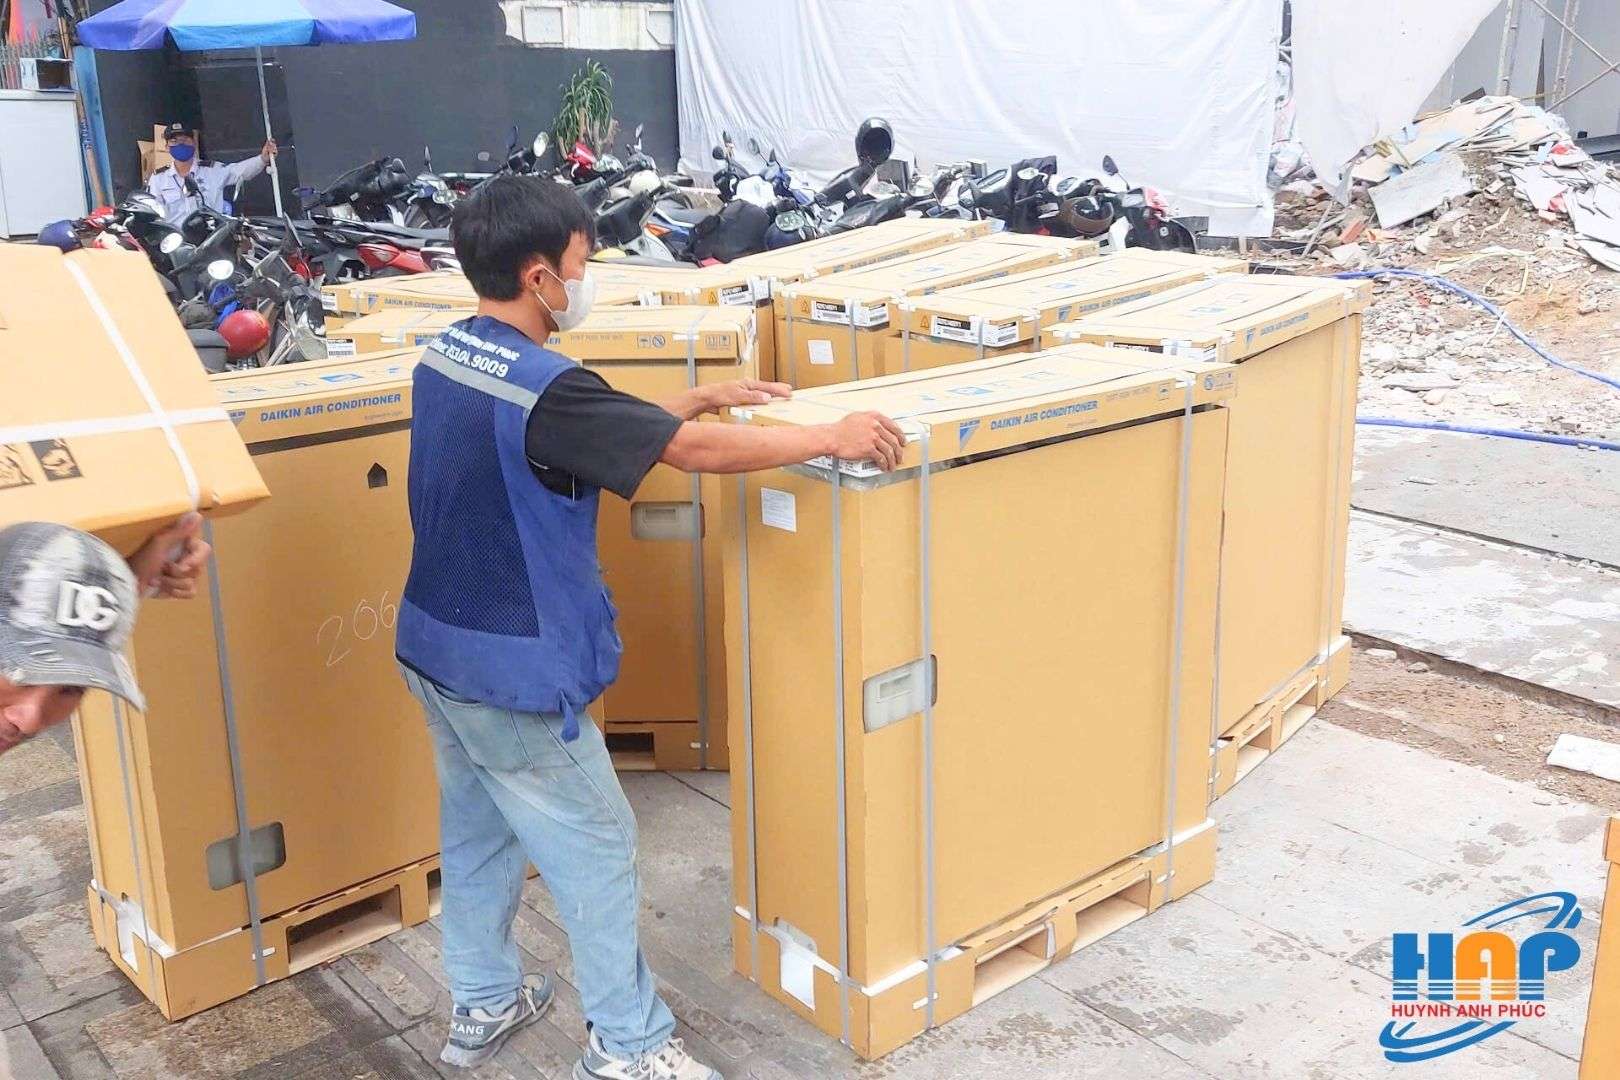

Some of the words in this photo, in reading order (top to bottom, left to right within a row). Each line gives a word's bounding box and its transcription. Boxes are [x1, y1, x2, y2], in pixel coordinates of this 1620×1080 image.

[260, 410, 301, 422] DAIKIN
[304, 405, 324, 416] AIR
[327, 393, 402, 413] CONDITIONER
[990, 416, 1022, 430] DAIKIN
[1023, 412, 1039, 424] AIR
[1040, 400, 1098, 420] CONDITIONER
[316, 591, 396, 667] 206
